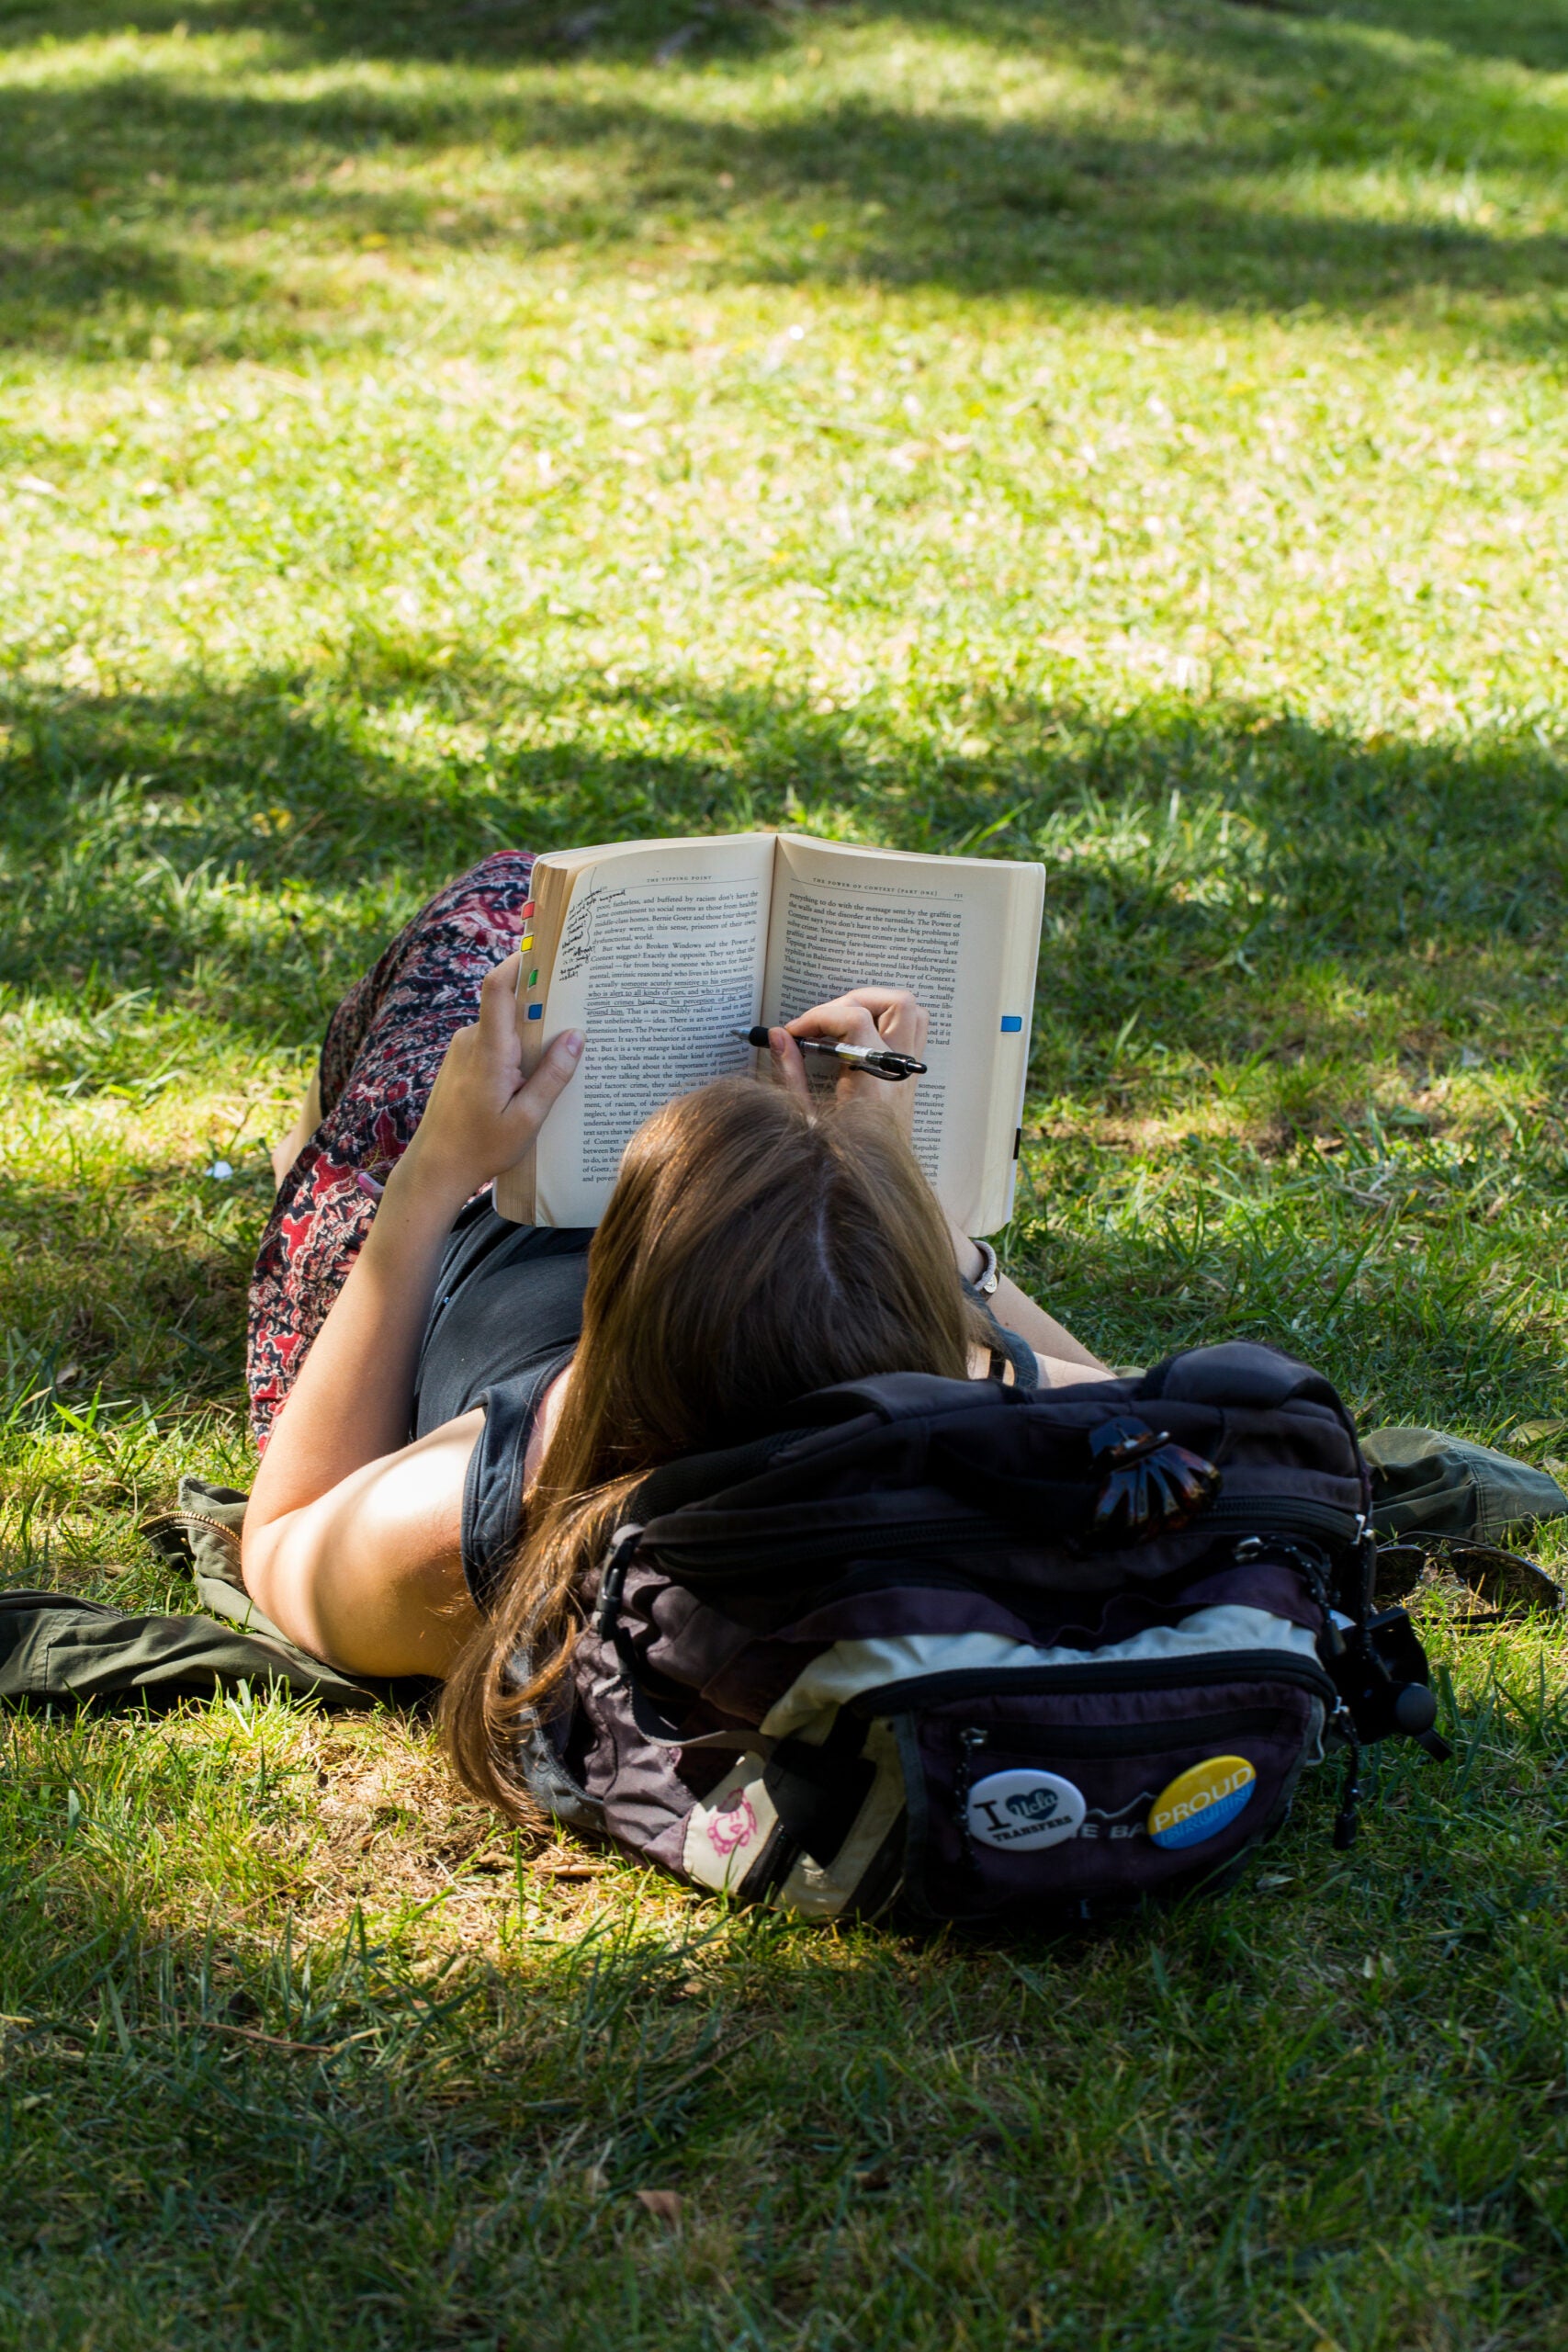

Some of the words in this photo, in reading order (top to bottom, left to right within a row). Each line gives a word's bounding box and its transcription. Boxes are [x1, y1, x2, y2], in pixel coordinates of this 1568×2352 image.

[788, 910, 809, 921] Context
[910, 927, 920, 935] big
[838, 911, 864, 919] disorder
[885, 914, 915, 924] turnstiles.
[907, 909, 916, 917] by
[691, 924, 718, 932] prisoners
[821, 925, 833, 934] You
[907, 936, 915, 944] by
[917, 938, 948, 947] scrubbing
[820, 938, 847, 946] arresting
[784, 955, 795, 964] This
[808, 943, 827, 951] Points
[901, 954, 949, 964] straightforward
[813, 953, 843, 963] Baltimore
[856, 959, 879, 967] fashion
[784, 966, 801, 974] radical
[803, 970, 824, 980] theory.
[937, 984, 954, 993] being
[1154, 1766, 1252, 1832] PROUD
[973, 1800, 1012, 1831] I
[992, 1815, 1073, 1842] TRANSFERS
